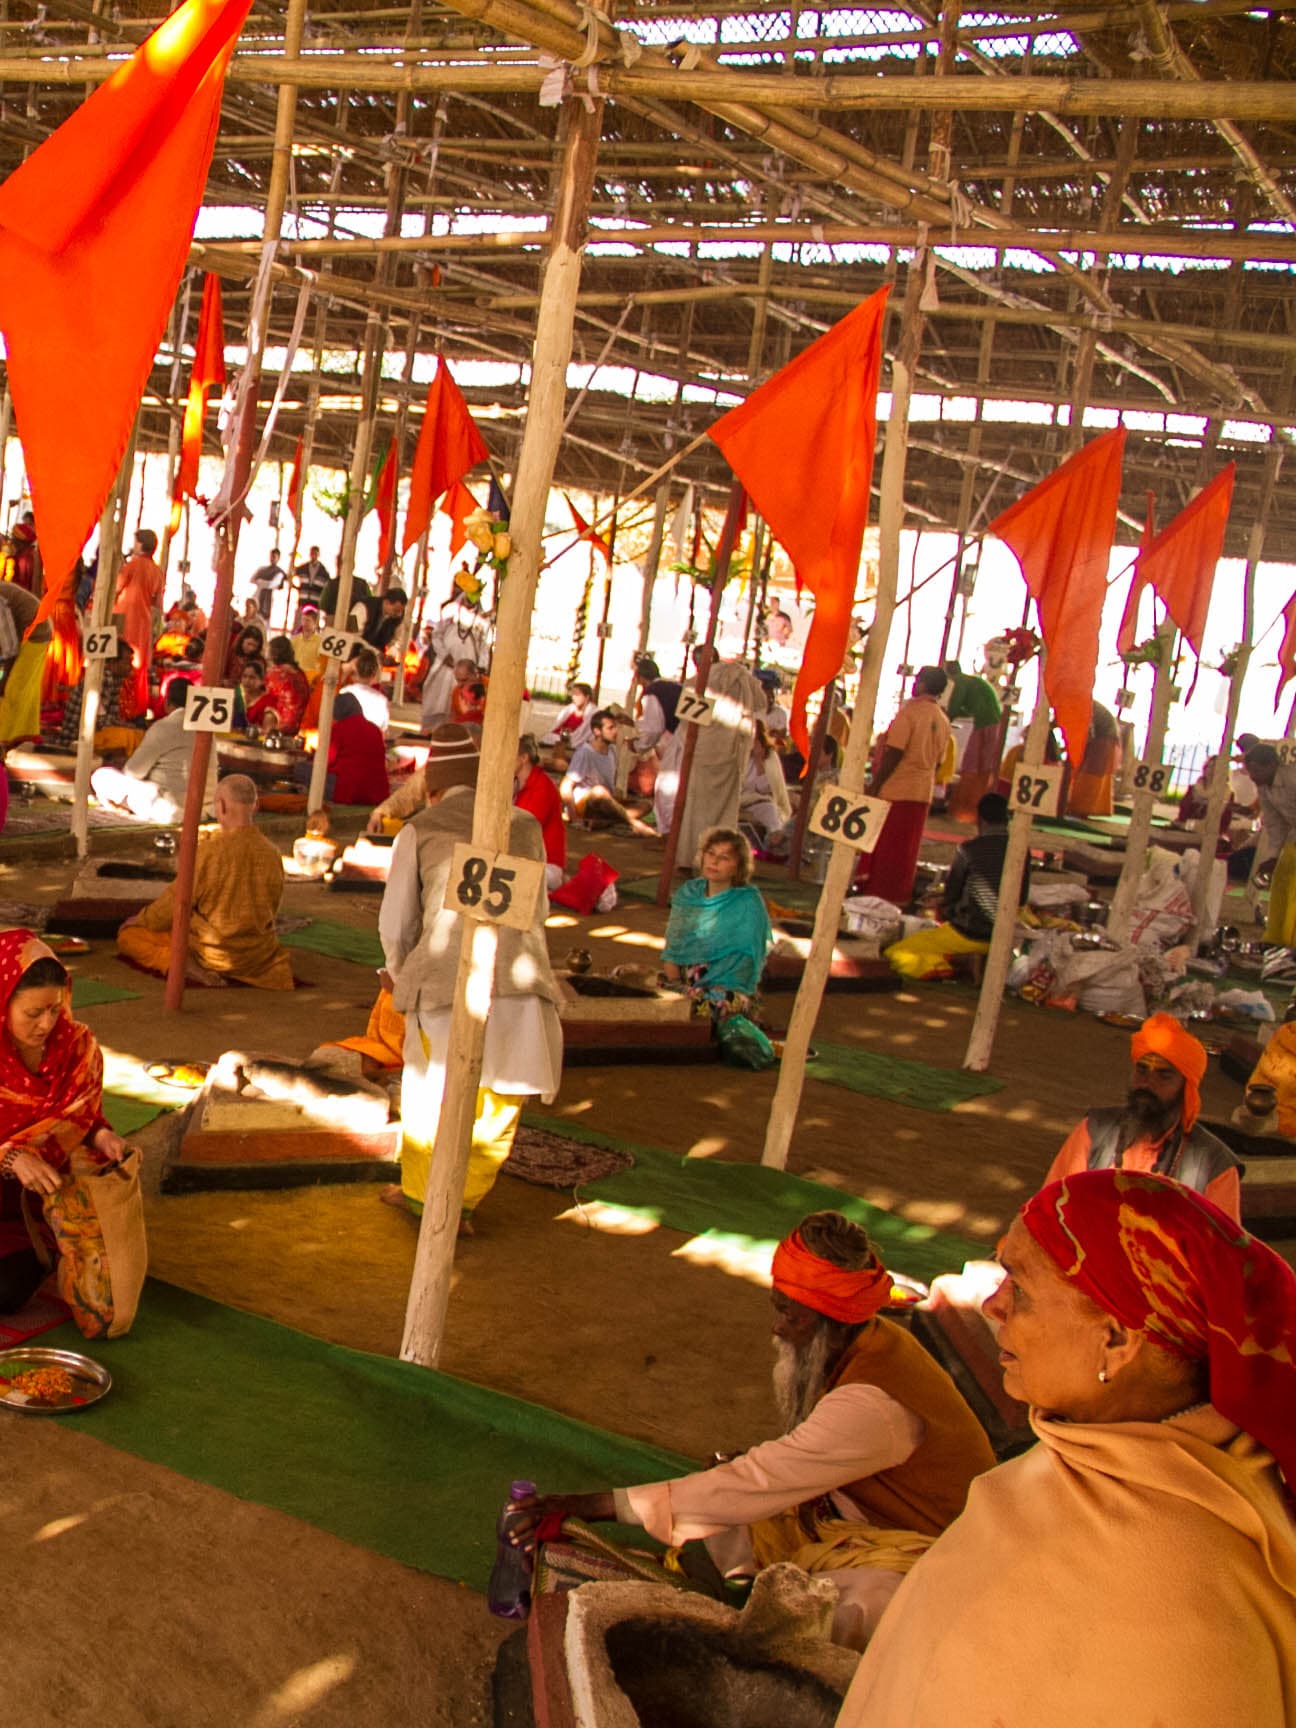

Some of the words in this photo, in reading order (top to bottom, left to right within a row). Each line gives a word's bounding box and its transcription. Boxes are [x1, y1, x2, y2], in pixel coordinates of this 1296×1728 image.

[87, 634, 112, 654] 67
[322, 635, 347, 657] 68
[191, 695, 228, 725] 75
[682, 696, 709, 719] 77
[1016, 775, 1049, 807] 87
[1134, 764, 1165, 793] 88
[821, 795, 871, 840] 86
[457, 859, 516, 918] 85
